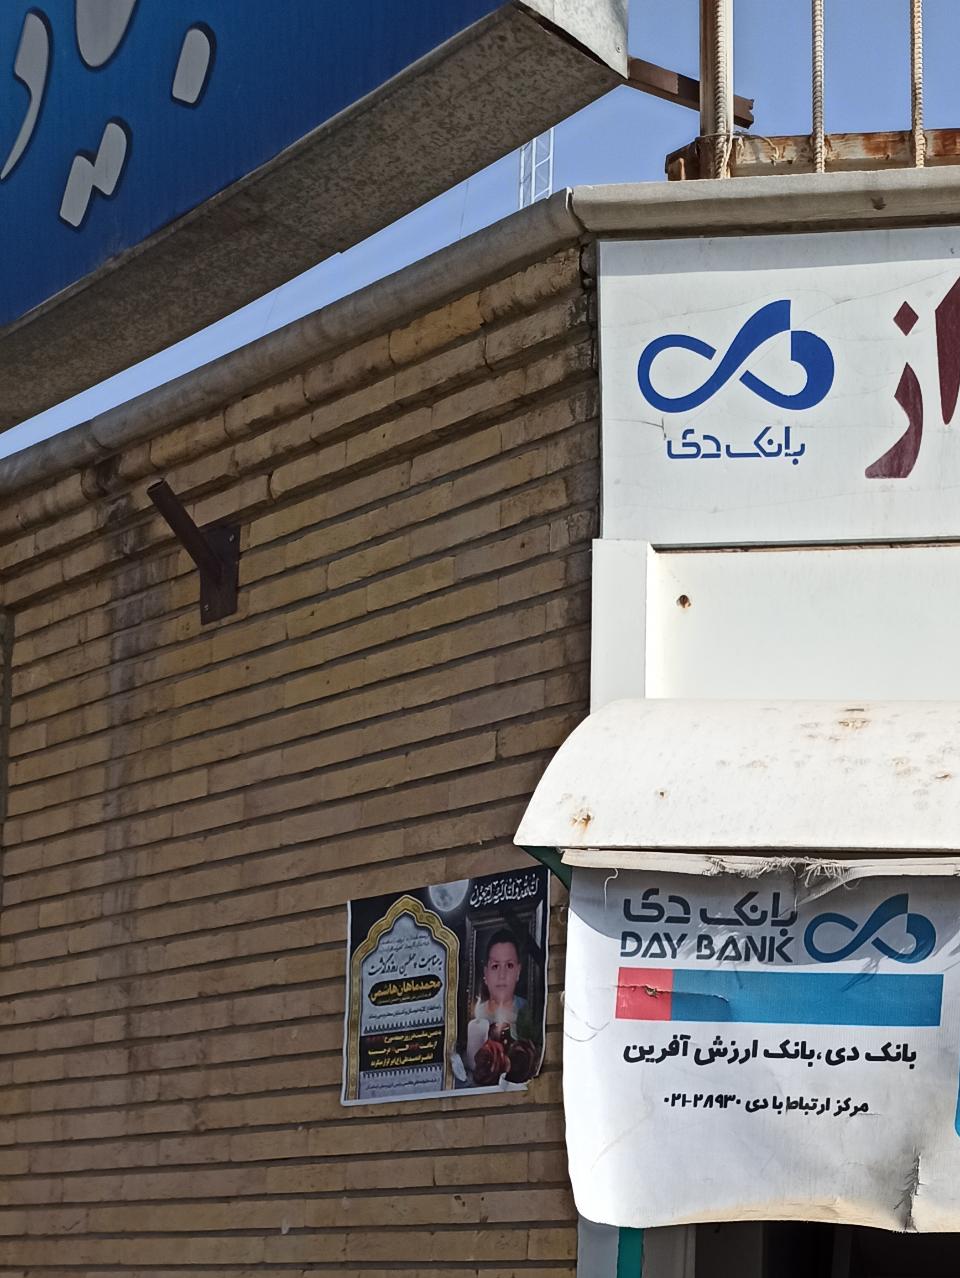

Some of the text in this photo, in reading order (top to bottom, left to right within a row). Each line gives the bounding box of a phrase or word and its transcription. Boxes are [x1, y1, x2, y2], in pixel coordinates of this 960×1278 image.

[666, 425, 805, 467] بانک دی
[623, 888, 798, 936] بانک دی
[620, 931, 794, 963] DAY BANK
[623, 1034, 691, 1064] آفرین
[694, 1036, 757, 1065] ارزش
[865, 1043, 917, 1069] بانک
[745, 1099, 769, 1114] دی
[772, 1096, 783, 1115] با
[786, 1096, 831, 1115] ارتباط
[833, 1097, 869, 1117] مرکز
